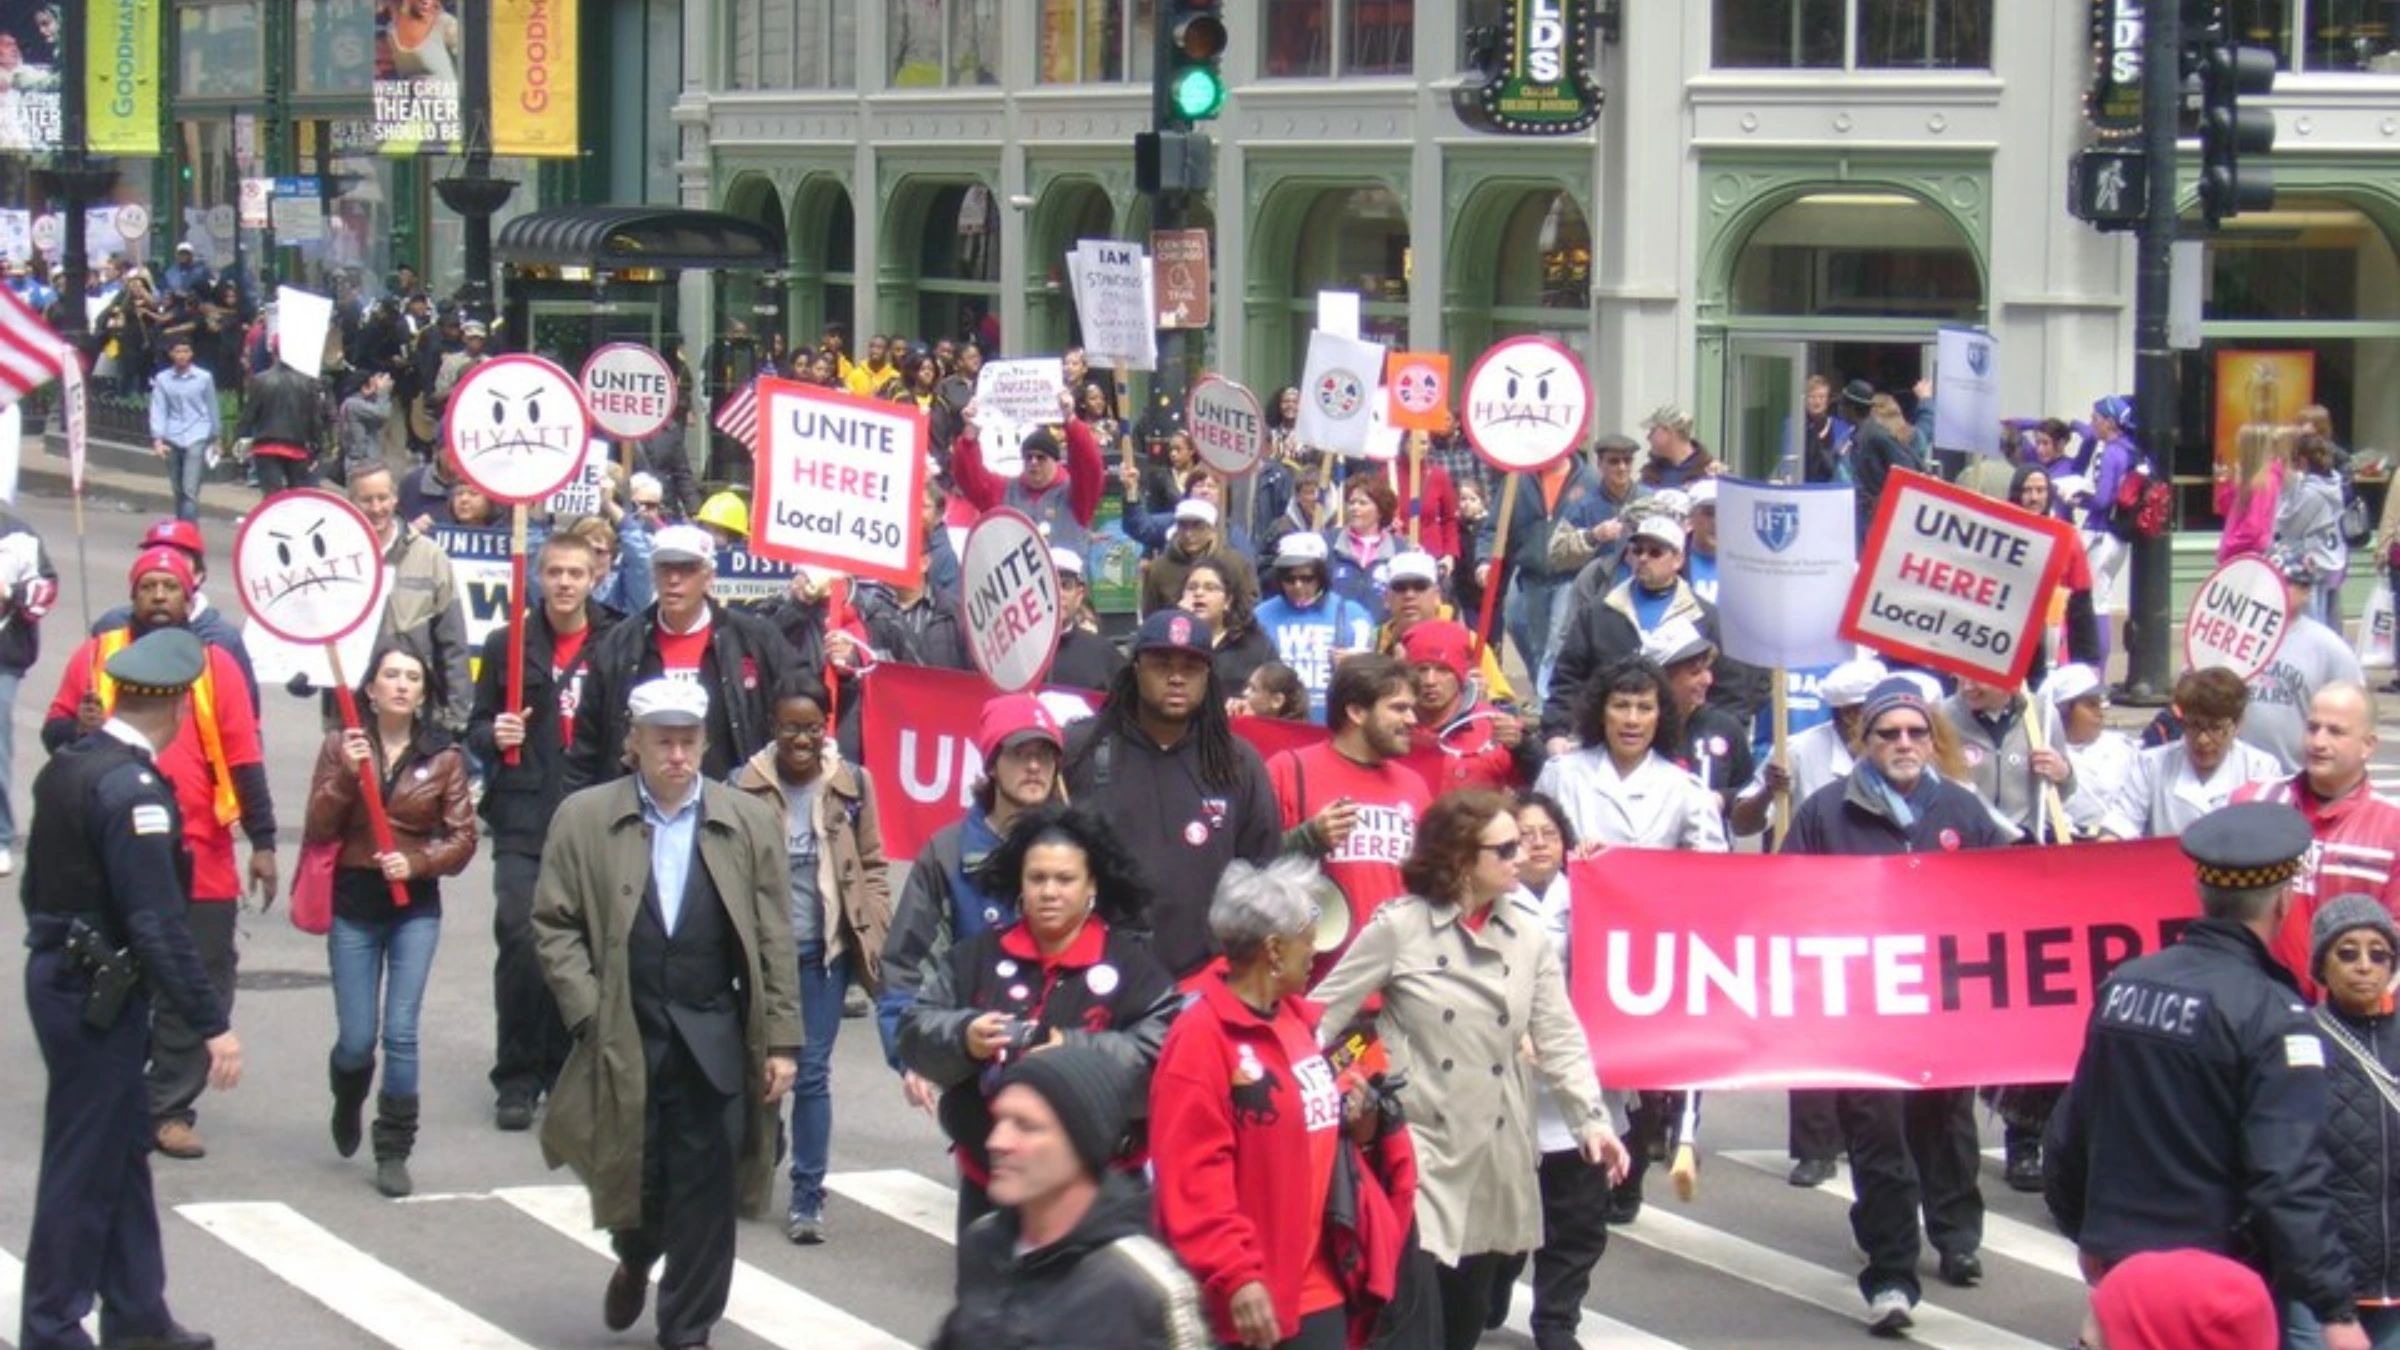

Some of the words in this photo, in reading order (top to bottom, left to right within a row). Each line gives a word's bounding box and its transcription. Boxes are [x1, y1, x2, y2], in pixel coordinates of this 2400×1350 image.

[1528, 0, 1563, 82] LDS
[374, 99, 460, 121] THEATER
[441, 122, 461, 141] BE
[590, 369, 666, 394] UNITE
[590, 391, 664, 418] HERE!
[792, 408, 894, 455] UNITE
[1194, 395, 1257, 433] UNITE
[1474, 400, 1577, 429] HYATT
[460, 424, 573, 456] HYATT
[1194, 421, 1256, 458] HERE!
[793, 456, 889, 503] HERE!
[553, 494, 596, 513] ONE
[776, 499, 843, 536] Local
[850, 516, 901, 549] 450
[436, 530, 514, 556] UNITE
[1914, 504, 2030, 568] UNITE
[250, 551, 365, 602] HYATT
[967, 535, 1042, 632] UNITE
[1898, 552, 2011, 611] HERE!
[982, 577, 1054, 675] HERE!
[1870, 591, 1947, 634] Local
[1952, 619, 2012, 656] 450
[2205, 581, 2282, 638] UNITE
[2192, 611, 2267, 668] HERE!
[1282, 659, 1332, 689] NE
[2102, 982, 2201, 1035] POLICE
